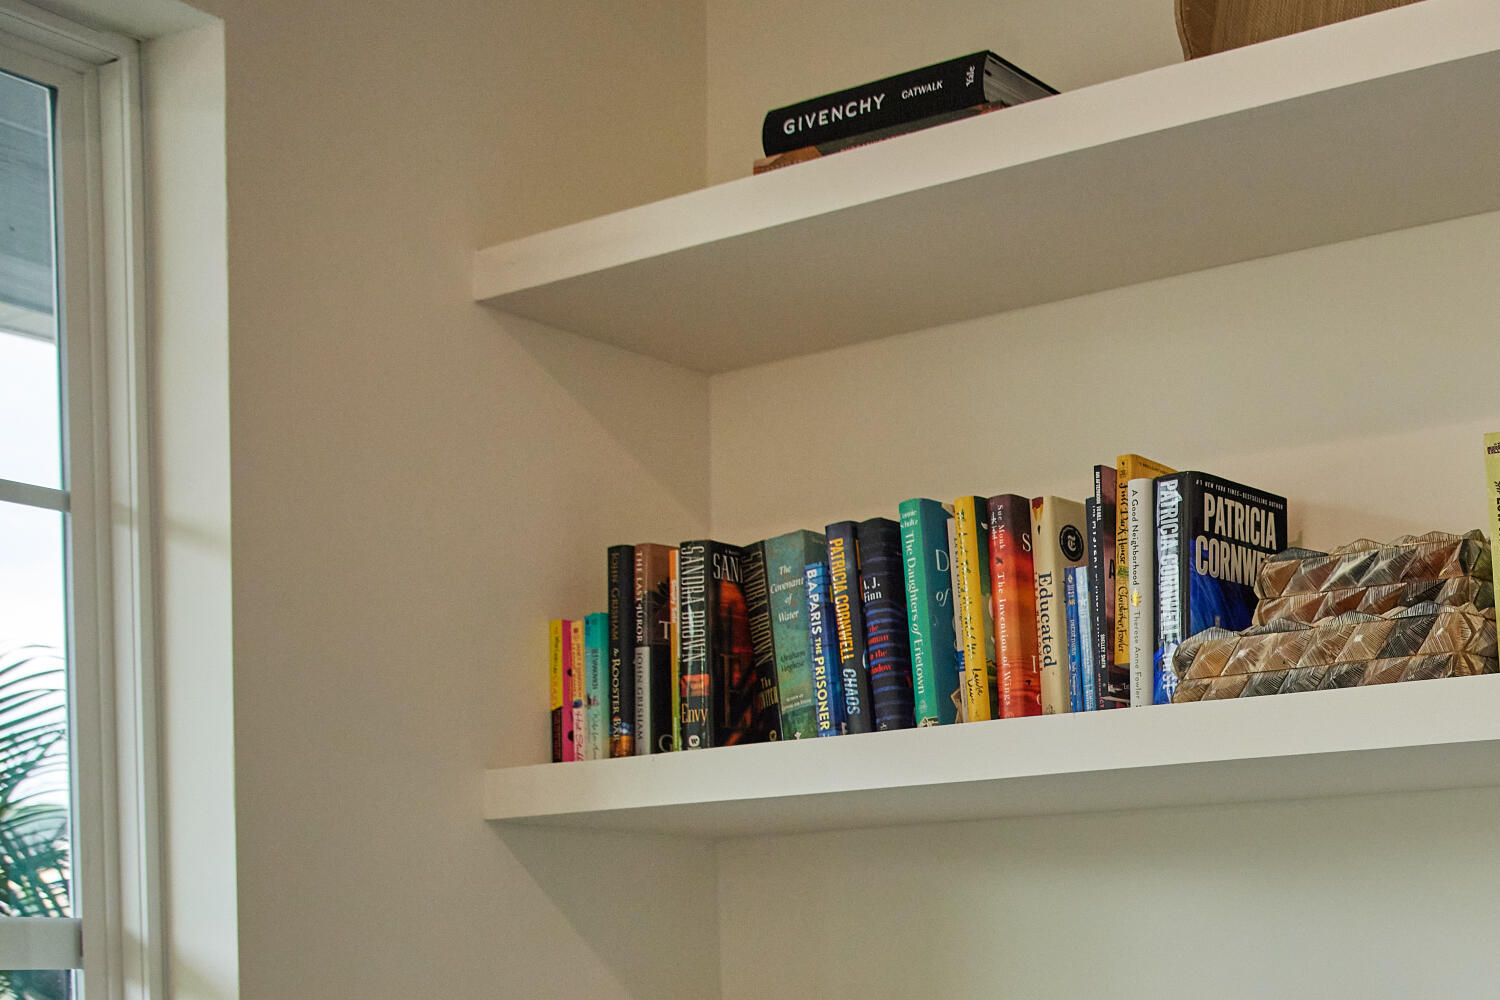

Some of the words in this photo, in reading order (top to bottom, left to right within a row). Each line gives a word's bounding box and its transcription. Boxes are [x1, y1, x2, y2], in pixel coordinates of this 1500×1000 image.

[783, 93, 885, 135] GIVENCHY
[901, 80, 943, 100] CATWALK
[905, 533, 914, 555] The
[1204, 492, 1277, 550] PATRICIA
[680, 545, 704, 608] SANDRA
[830, 538, 847, 594] PATRICIA
[1132, 524, 1140, 586] Neighborhood
[906, 558, 920, 621] Daughters
[681, 610, 706, 663] BROWN
[835, 595, 854, 663] CORNWELL
[912, 624, 922, 636] of
[1038, 573, 1057, 668] Educated
[843, 669, 860, 715] CHAOS
[912, 639, 924, 694] Erietown
[681, 703, 708, 723] Envy
